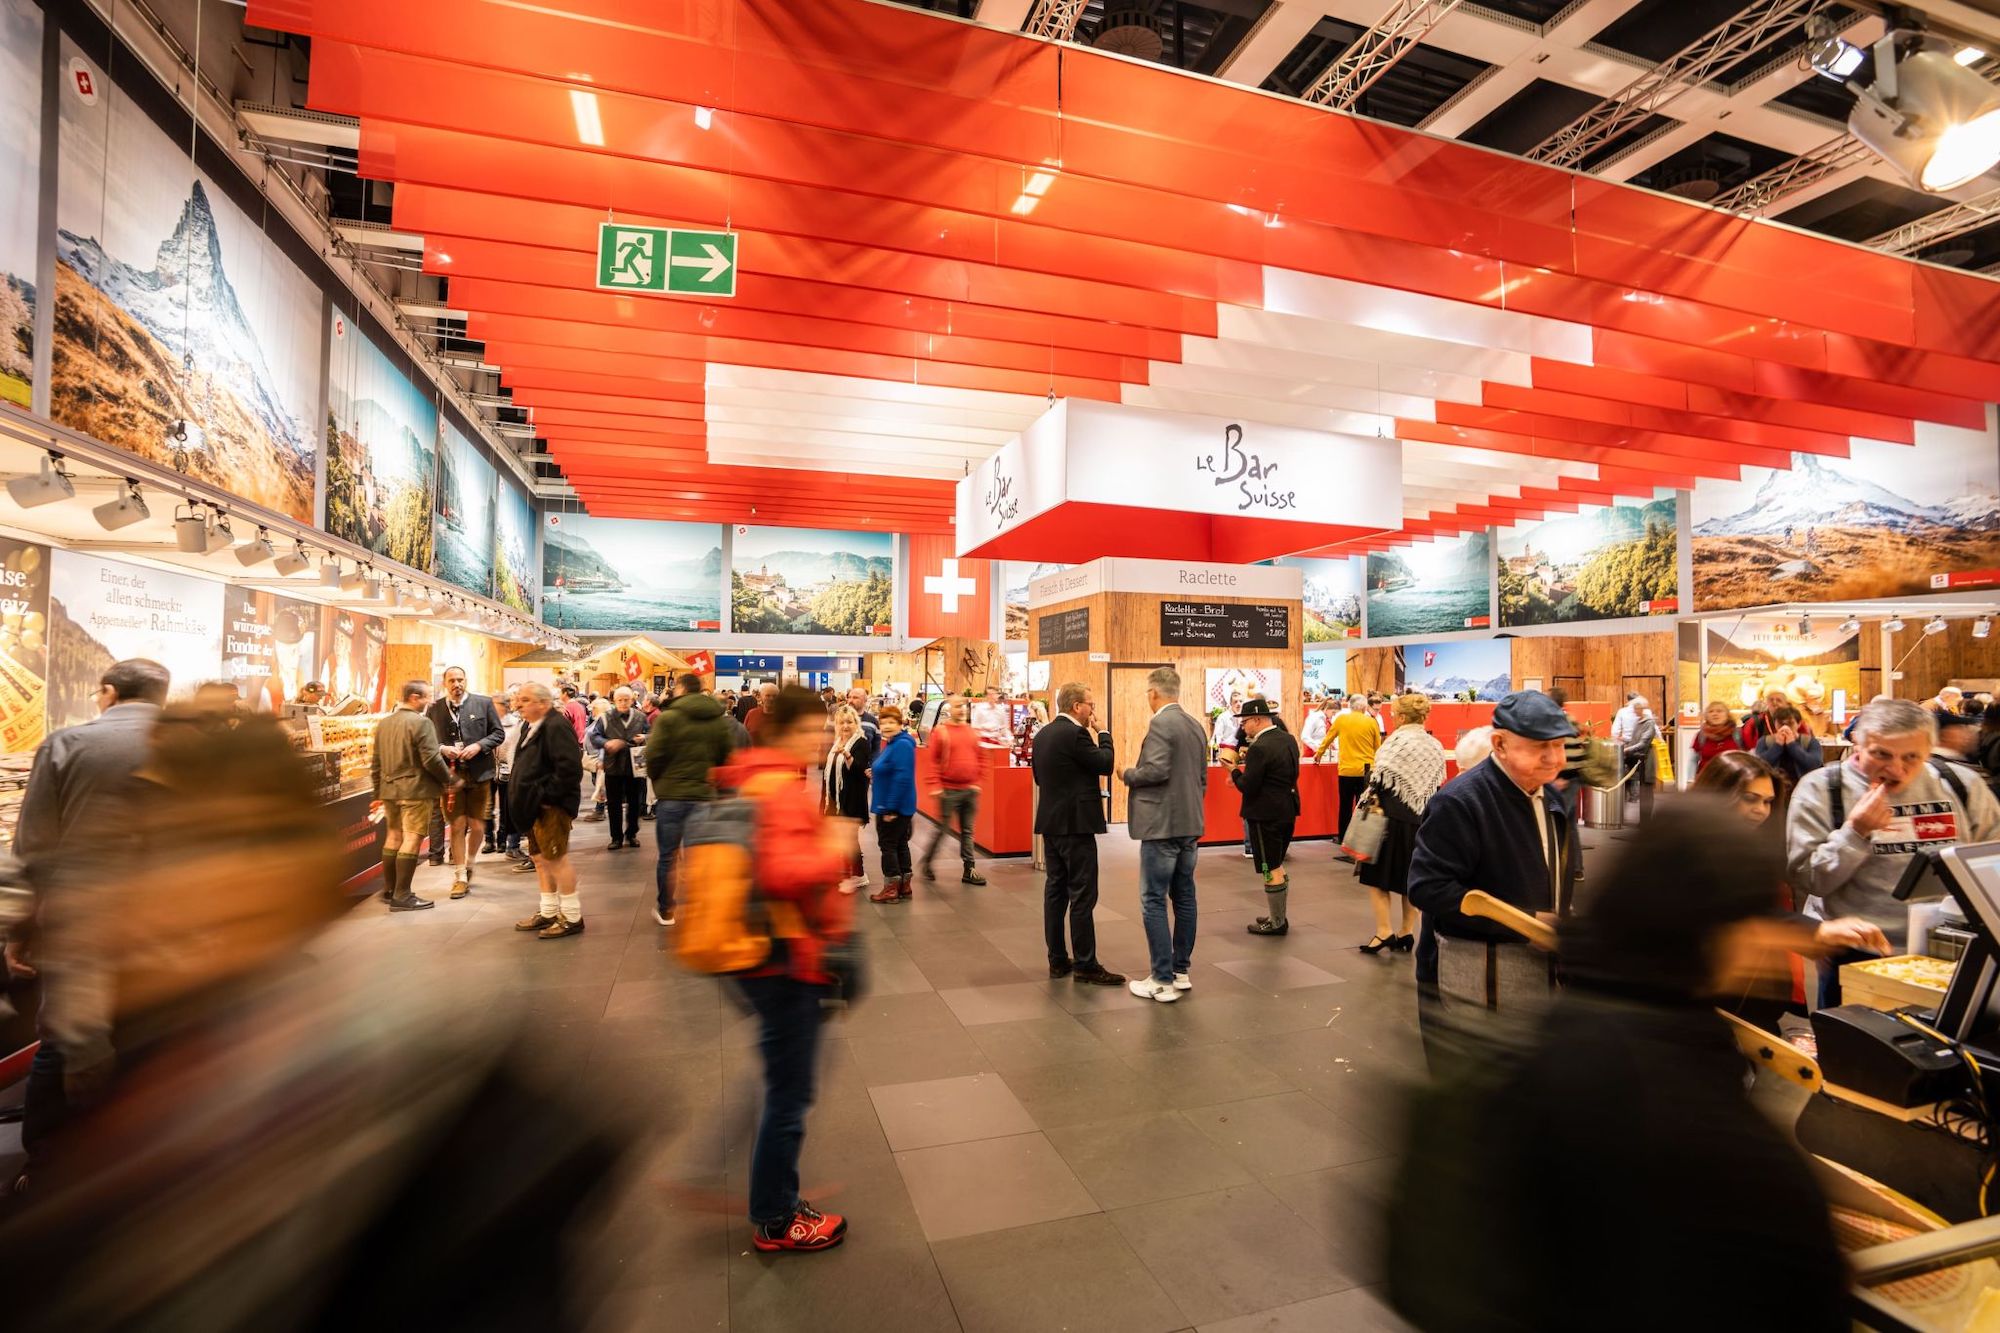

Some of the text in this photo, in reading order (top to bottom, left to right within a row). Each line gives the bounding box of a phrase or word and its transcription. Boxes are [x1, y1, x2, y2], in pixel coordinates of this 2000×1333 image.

[1196, 423, 1278, 487] Le Bar
[991, 455, 1012, 516] Bar
[1238, 480, 1296, 510] Suisse
[997, 498, 1019, 530] Suisse
[100, 567, 147, 589] Einer, der
[1178, 569, 1238, 586] Raclette
[106, 587, 132, 606] allen
[243, 601, 257, 615] Das
[1164, 602, 1197, 614] Raclette
[1204, 604, 1225, 616] Brot
[150, 612, 208, 637] Rahmkäse
[226, 634, 262, 656] Fondue
[737, 658, 743, 668] 1
[758, 658, 766, 668] 6
